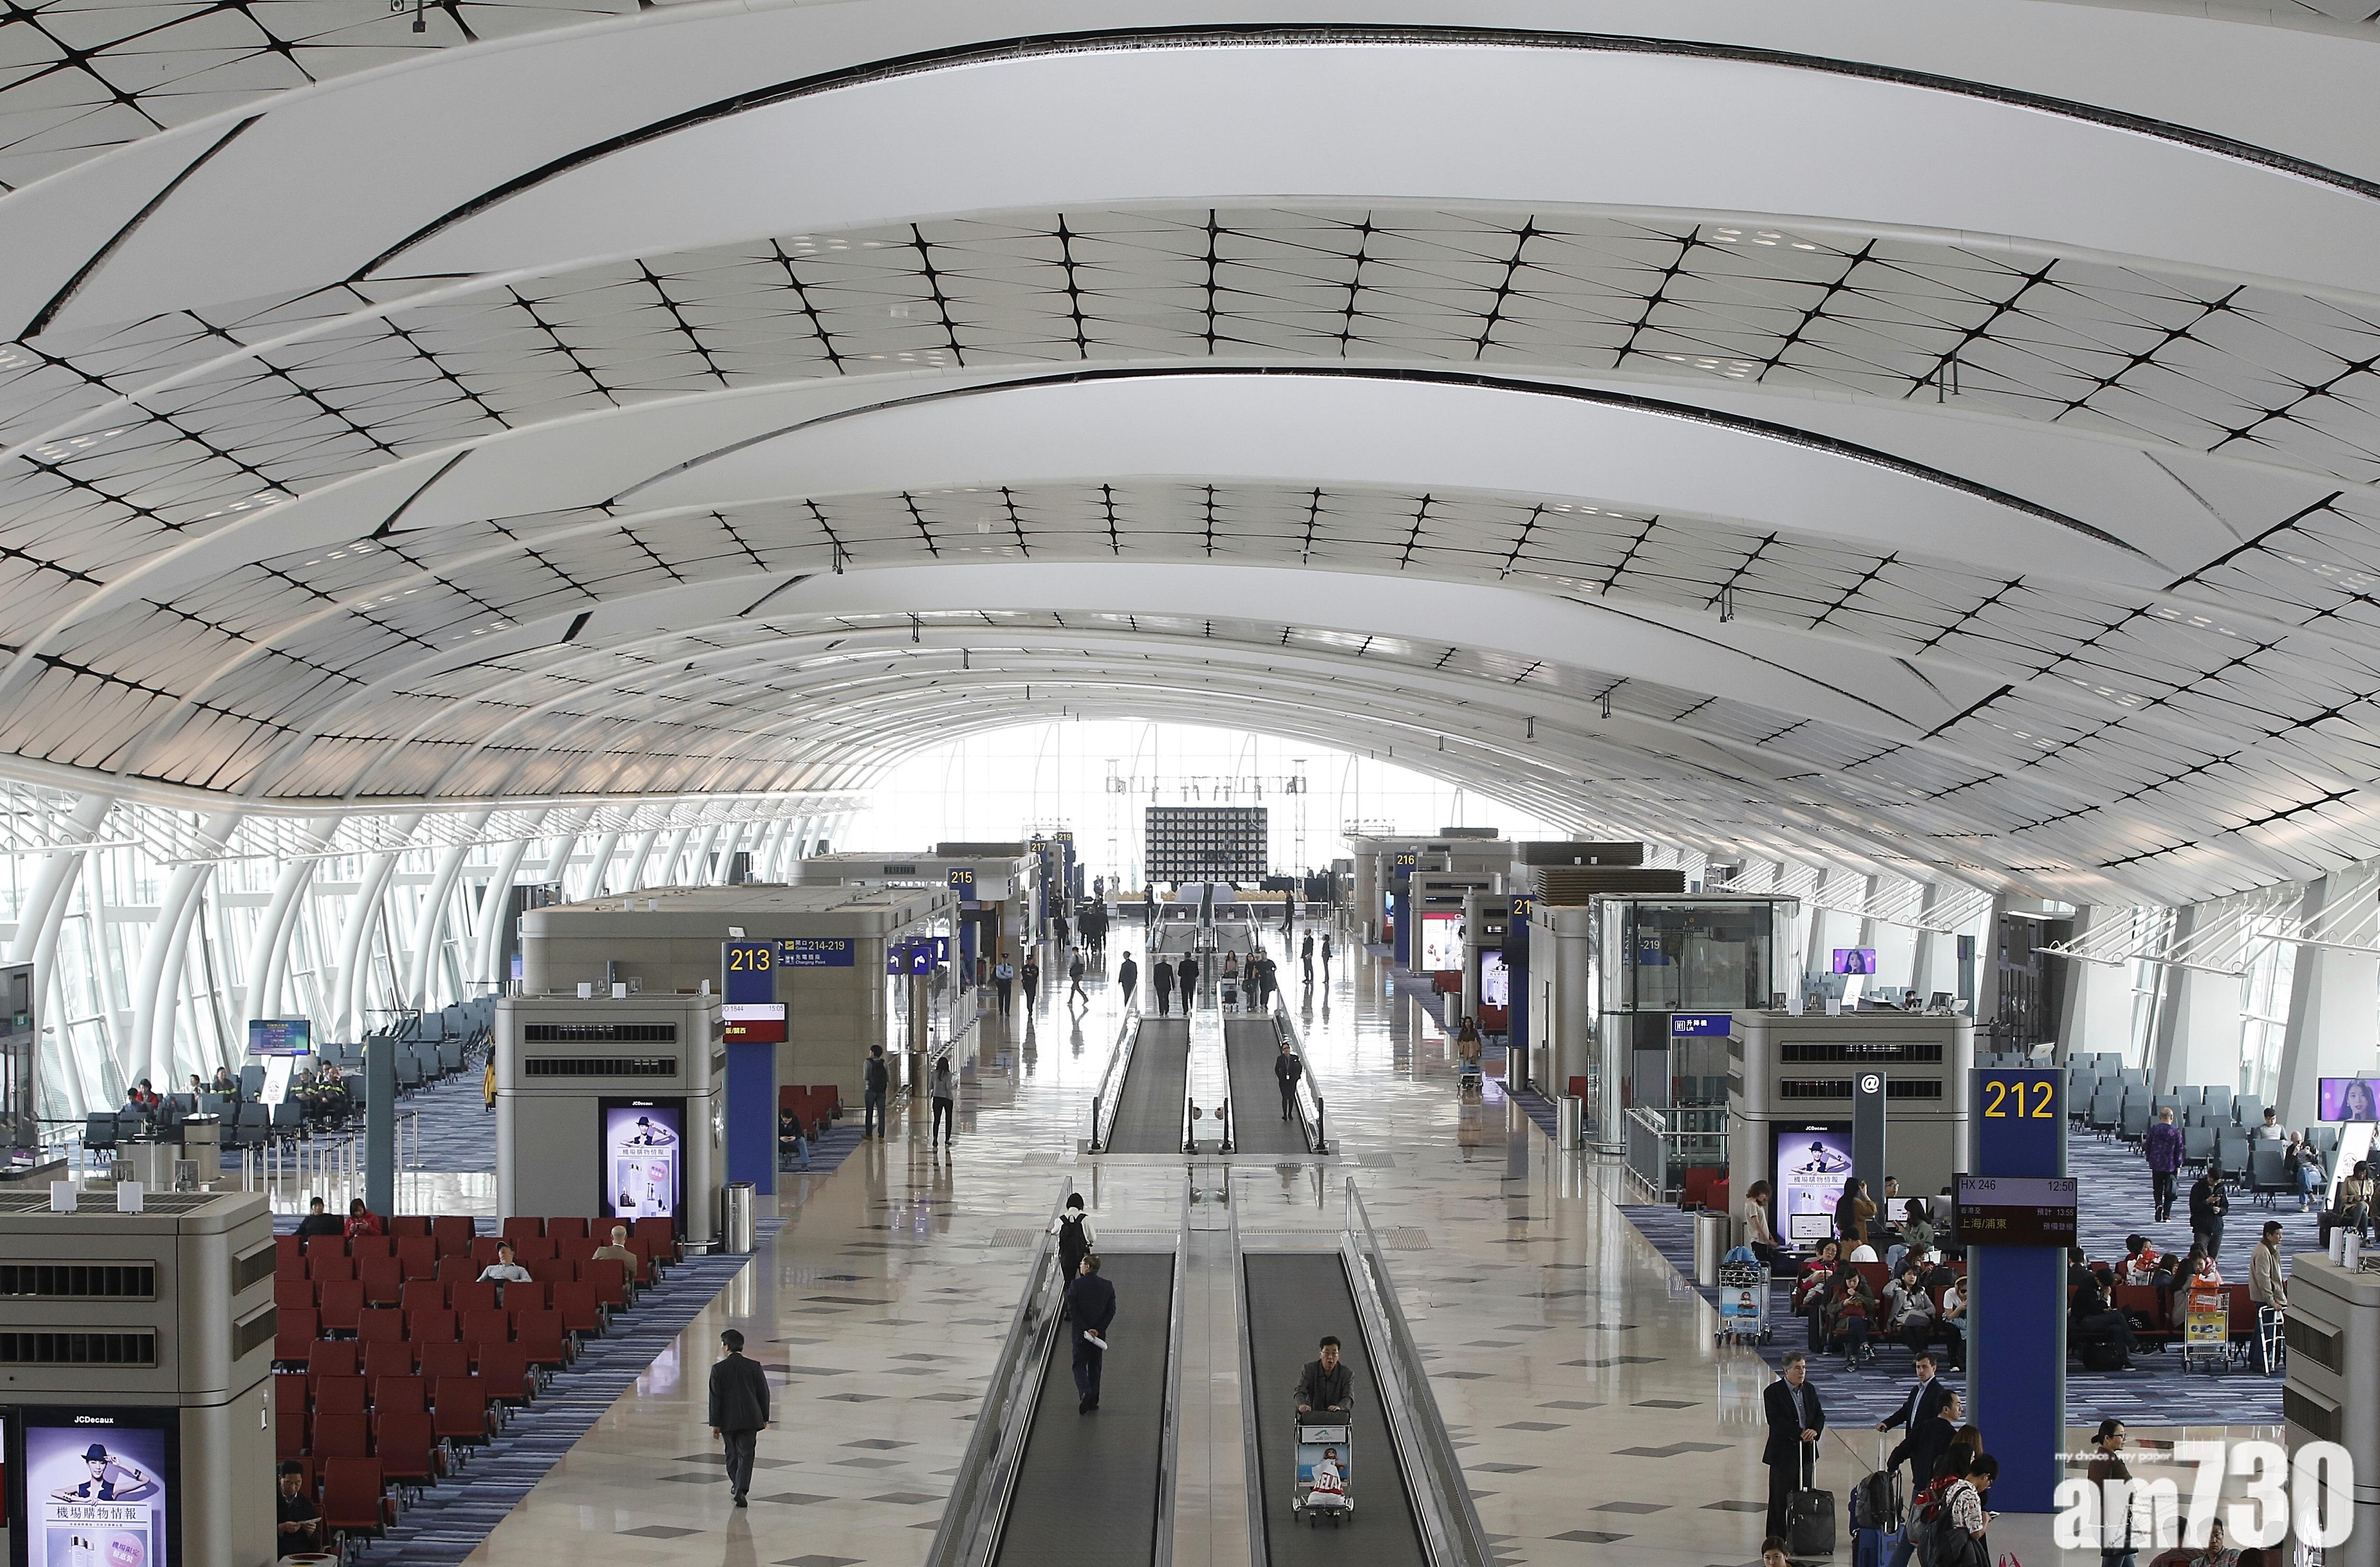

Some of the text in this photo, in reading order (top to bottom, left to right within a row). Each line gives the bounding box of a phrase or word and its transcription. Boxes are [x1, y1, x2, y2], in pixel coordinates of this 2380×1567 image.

[1397, 855, 1414, 865] 216
[951, 872, 973, 883] 215
[1514, 899, 1531, 914] 21
[808, 941, 845, 950] 214-219
[1625, 940, 1660, 949] 2-219
[730, 949, 770, 970] 213
[1861, 1075, 1880, 1094] @
[1984, 1080, 2053, 1119] 212
[1961, 1179, 2074, 1192] HX 246 12:50
[1960, 1218, 2073, 1231] 上海/浦東 預備登機
[56, 1506, 136, 1520] 機場購物情報
